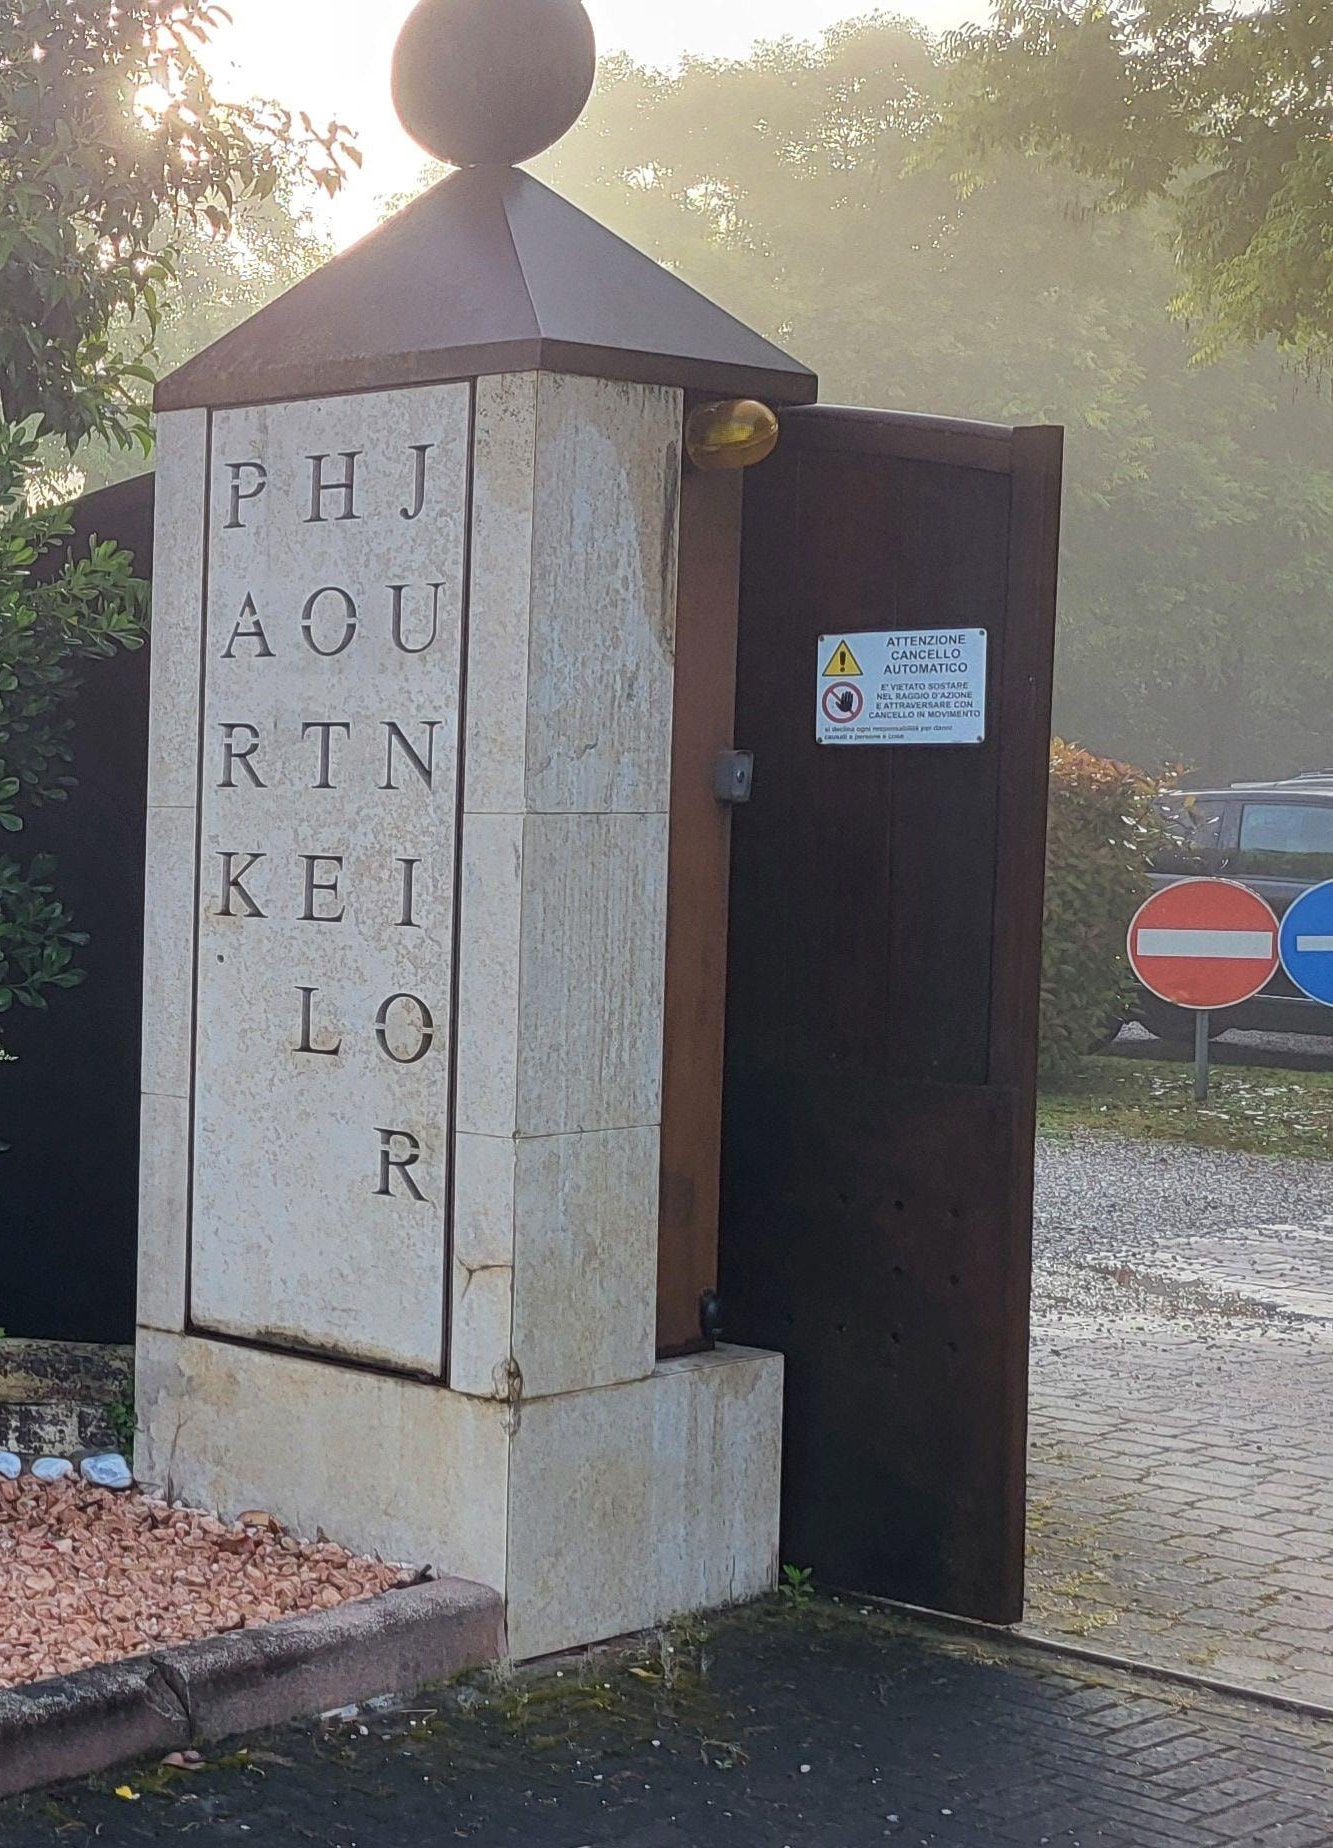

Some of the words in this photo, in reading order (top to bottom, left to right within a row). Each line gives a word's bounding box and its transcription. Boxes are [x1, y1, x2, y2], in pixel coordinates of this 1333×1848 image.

[886, 634, 966, 647] ATTENZIONE
[891, 648, 961, 660] CANCELLO
[883, 662, 968, 675] AUTOMATICO
[213, 461, 277, 919] PARK
[890, 682, 926, 691] VIETATO
[928, 681, 969, 690] SOSTARE
[895, 692, 930, 700] RAGGIO
[932, 691, 973, 699] D'AZIONE
[883, 701, 951, 709] ATTRAVERSARE
[868, 711, 915, 719] CANCELLO
[927, 710, 981, 718] MOVIMENTO
[292, 450, 363, 1057] HOTEL
[371, 442, 447, 1202] JUNIOR
